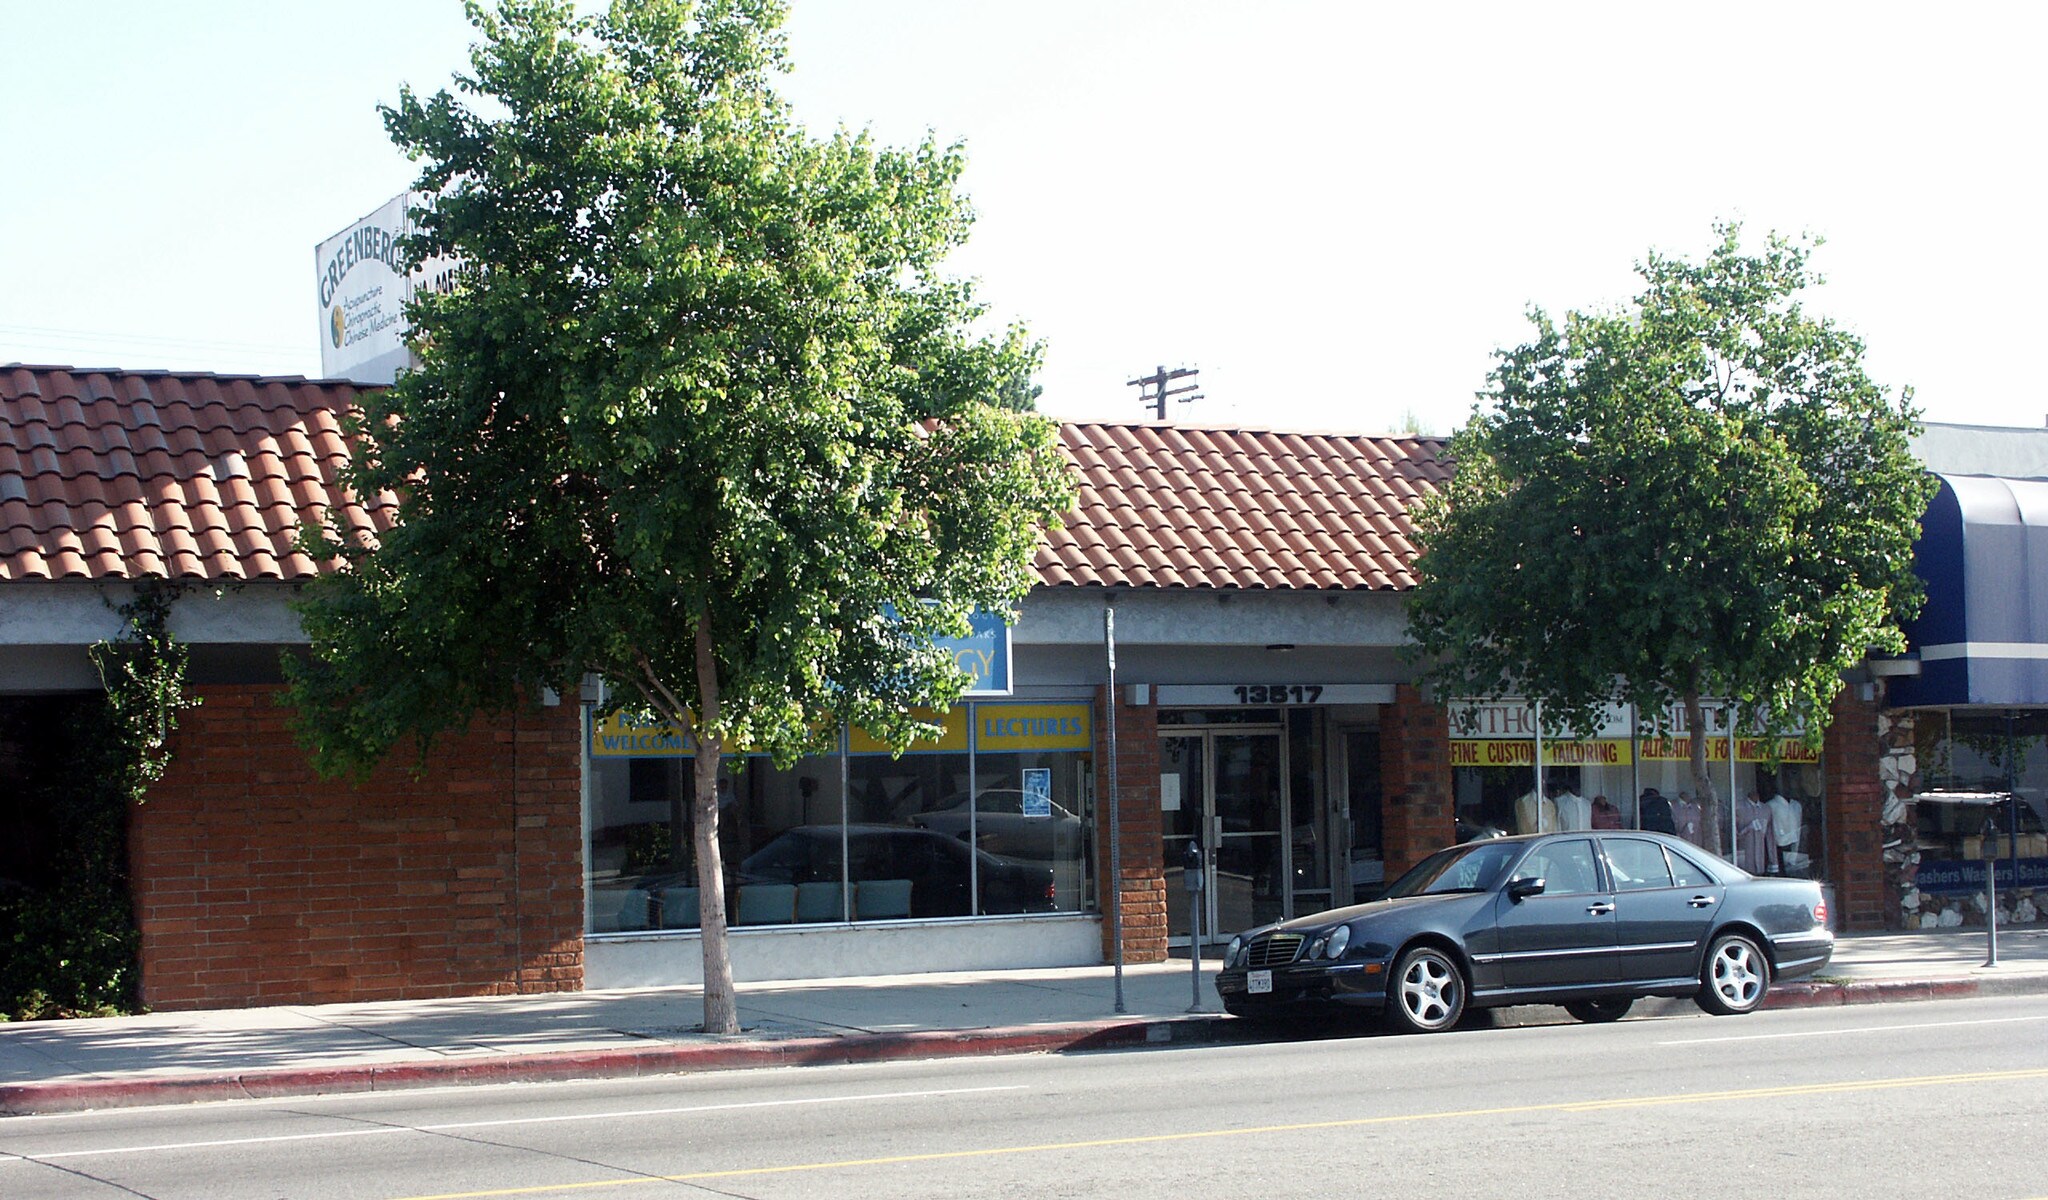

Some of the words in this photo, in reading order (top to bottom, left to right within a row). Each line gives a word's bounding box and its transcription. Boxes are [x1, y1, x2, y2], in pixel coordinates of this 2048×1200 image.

[343, 285, 383, 311] Acupuncture
[343, 301, 382, 330] Chiropractic
[343, 329, 369, 347] Chinese
[369, 313, 398, 336] Medicine
[1233, 685, 1323, 704] 13517
[985, 716, 1083, 738] LECTURES
[1451, 743, 1478, 763] FINE
[1553, 742, 1618, 762] TAILORING
[1715, 739, 1735, 759] FO
[1914, 868, 1960, 885] ashers
[1961, 867, 2014, 882] Wasers
